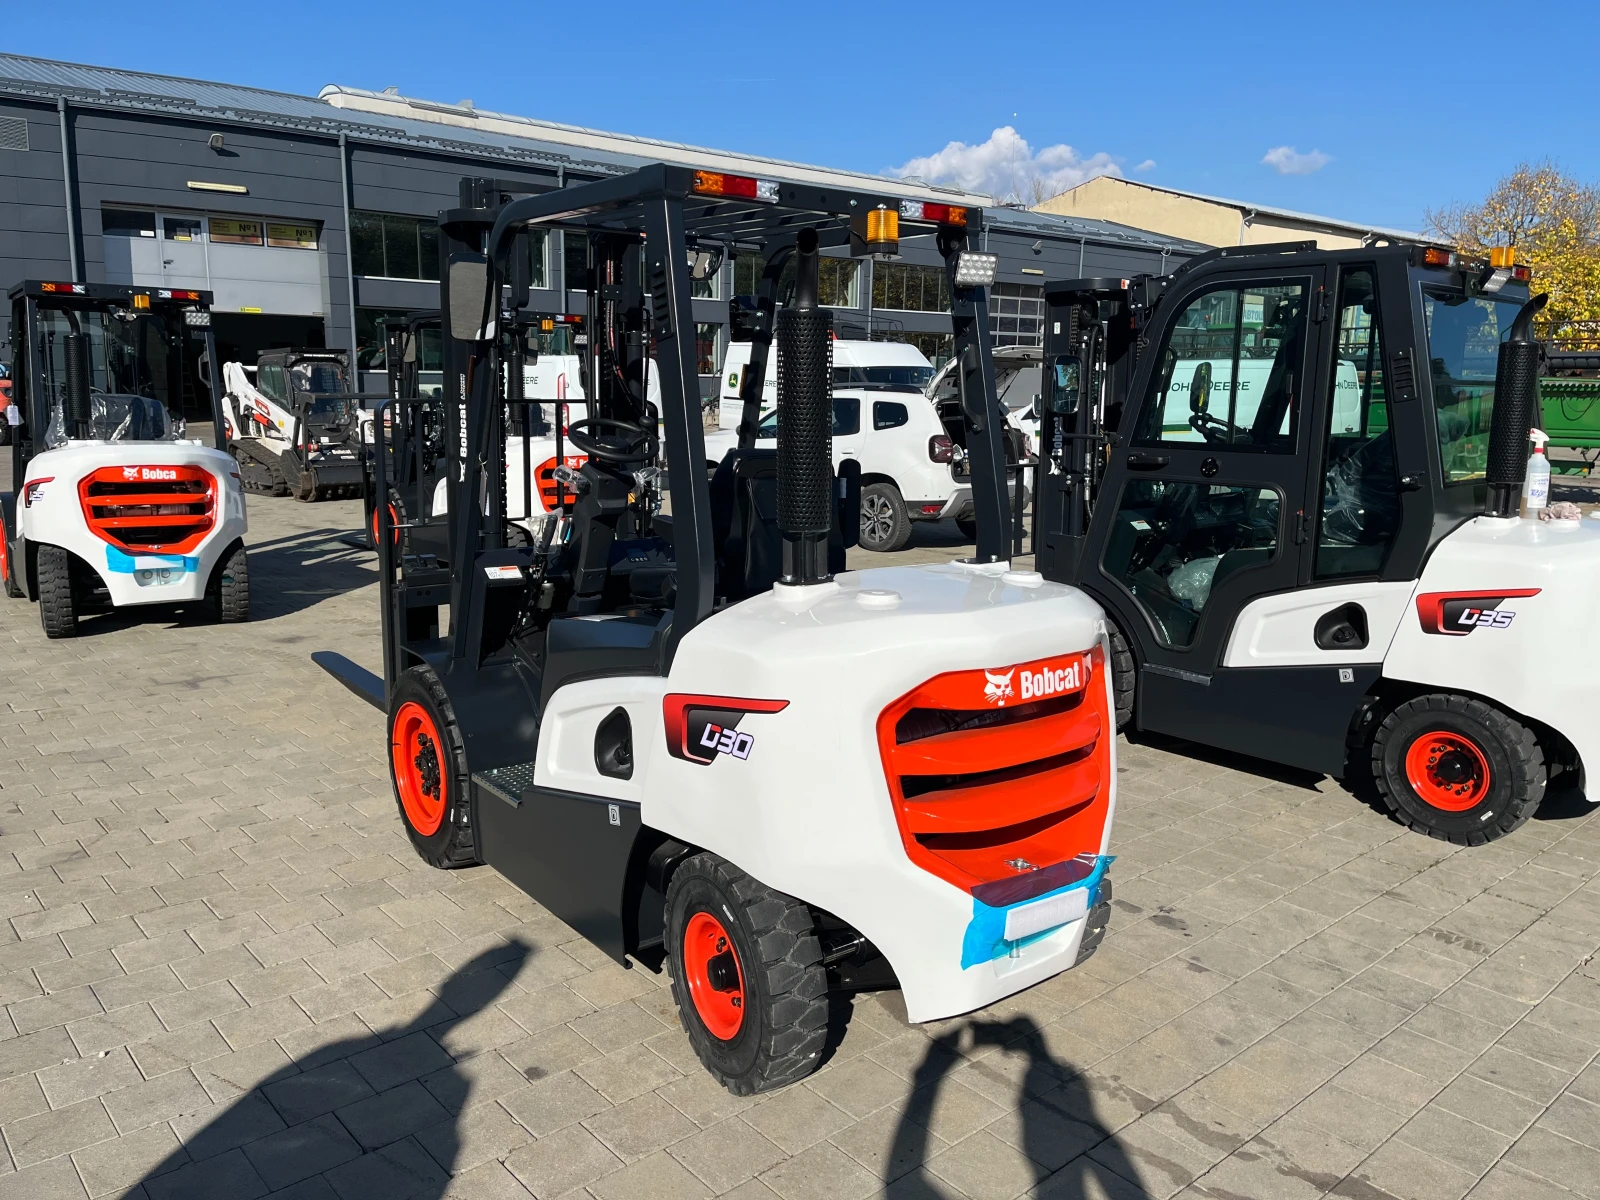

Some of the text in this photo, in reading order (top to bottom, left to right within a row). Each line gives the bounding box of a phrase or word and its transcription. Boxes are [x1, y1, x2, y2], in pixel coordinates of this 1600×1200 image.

[458, 403, 468, 458] Bobcat
[1457, 608, 1516, 629] D35
[1020, 661, 1080, 700] Bobcat
[700, 722, 755, 761] D30
